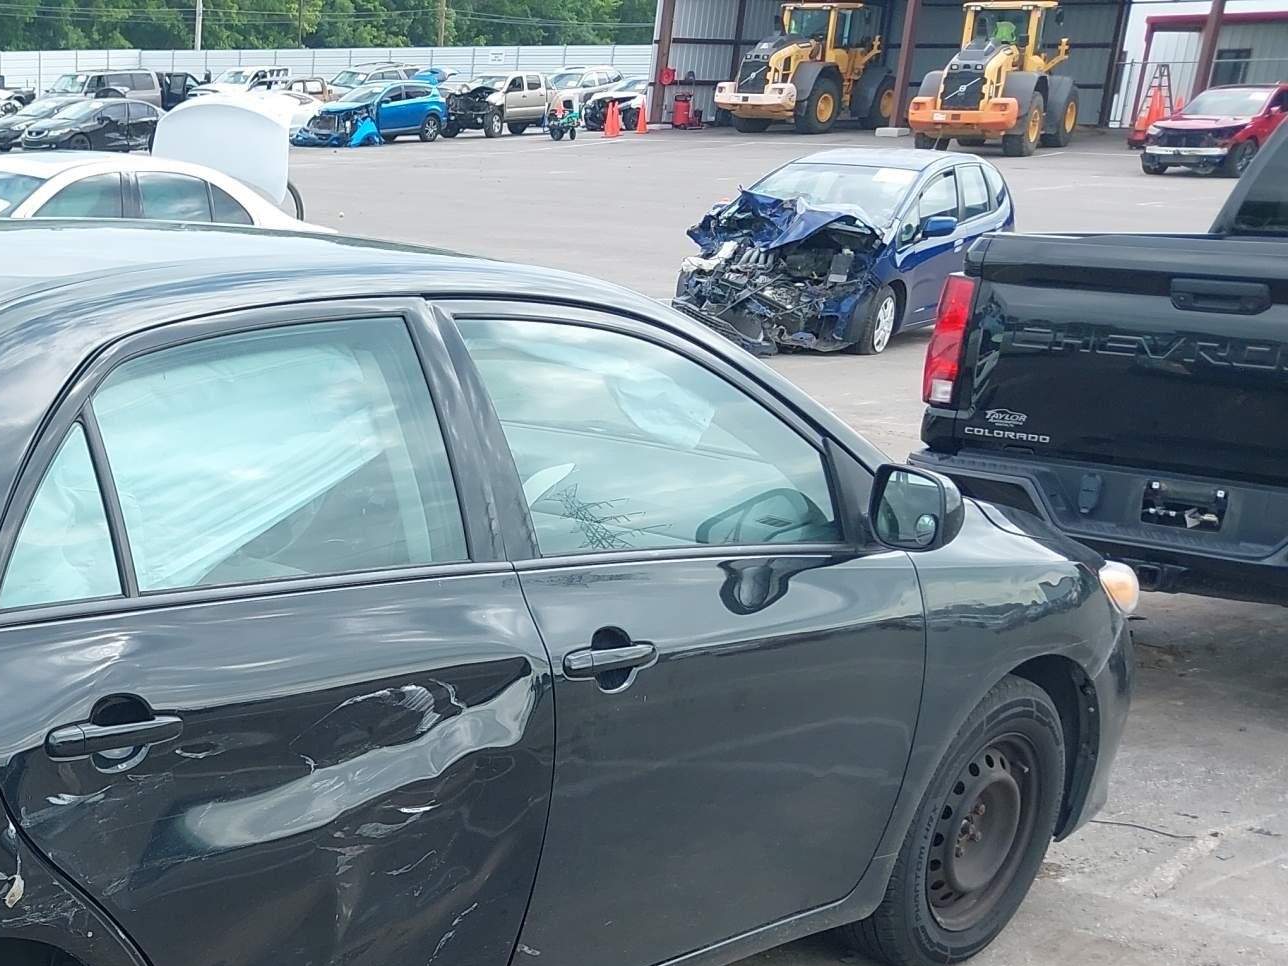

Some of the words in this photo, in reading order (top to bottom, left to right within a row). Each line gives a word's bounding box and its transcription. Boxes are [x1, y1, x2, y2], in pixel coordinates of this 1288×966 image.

[1011, 327, 1288, 372] CHEVRO
[985, 409, 1027, 422] TAYLOR
[964, 426, 1050, 443] COLORADO
